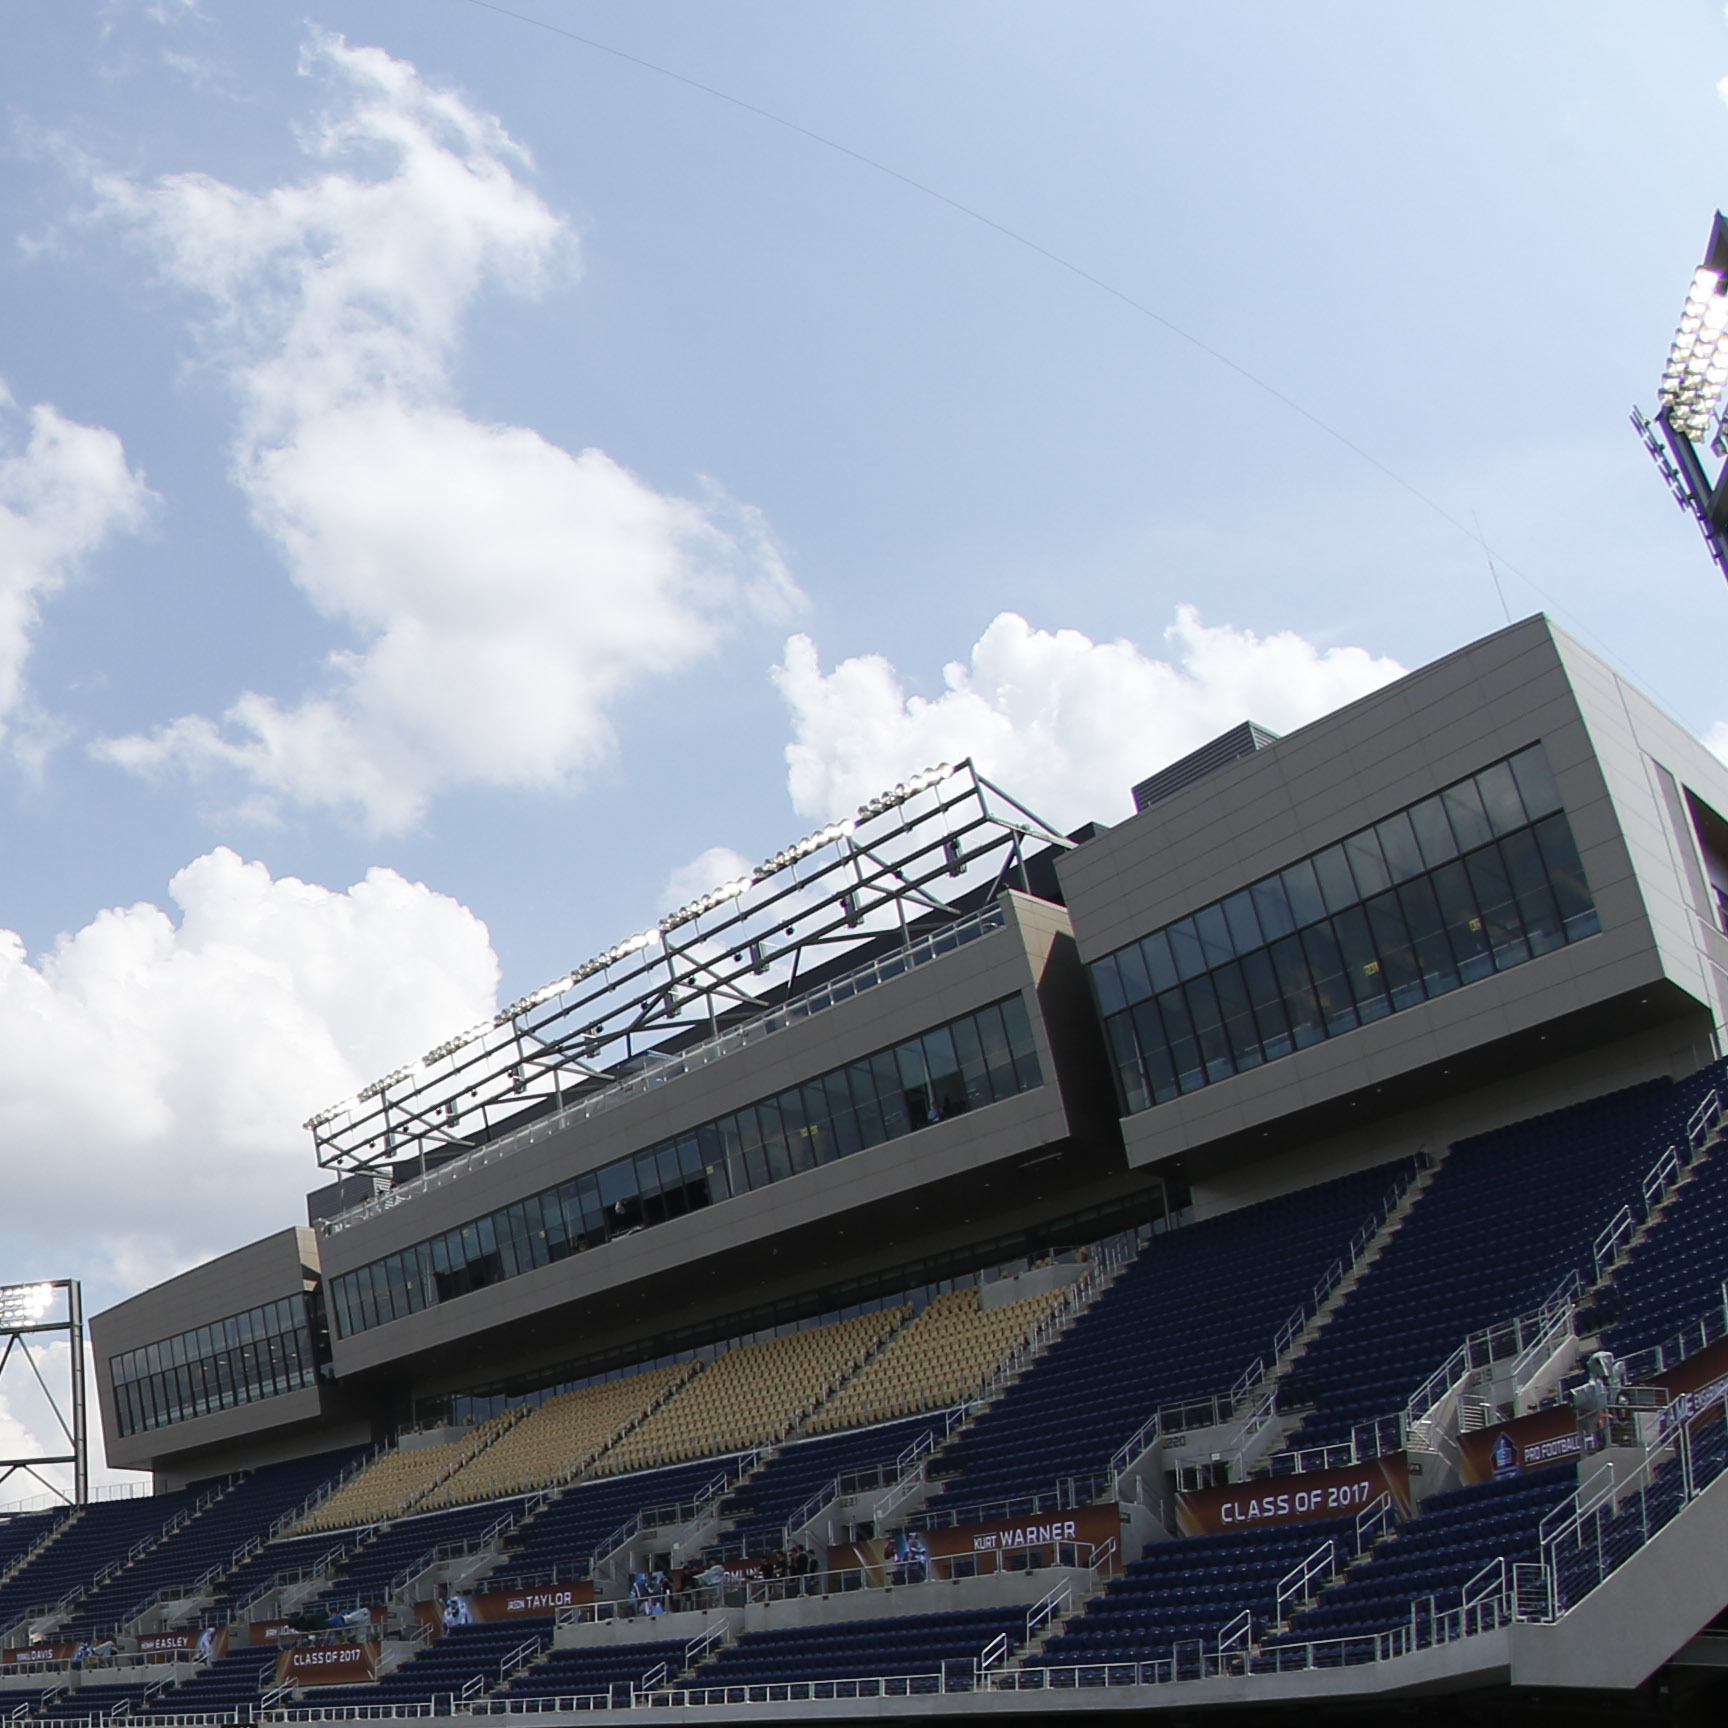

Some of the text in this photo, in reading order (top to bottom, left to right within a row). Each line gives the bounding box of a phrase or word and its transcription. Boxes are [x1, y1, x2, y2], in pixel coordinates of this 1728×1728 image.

[1524, 1447, 1541, 1461] PRO
[1541, 1438, 1581, 1457] FOOTBALL
[1221, 1481, 1370, 1522] CLASS OF 2017
[973, 1521, 1075, 1550] KURT WARNER
[526, 1592, 572, 1608] TAYLOR
[155, 1637, 189, 1649] EASLEY
[31, 1649, 54, 1660] DAVIS
[294, 1649, 361, 1666] CLASS OF 2017
